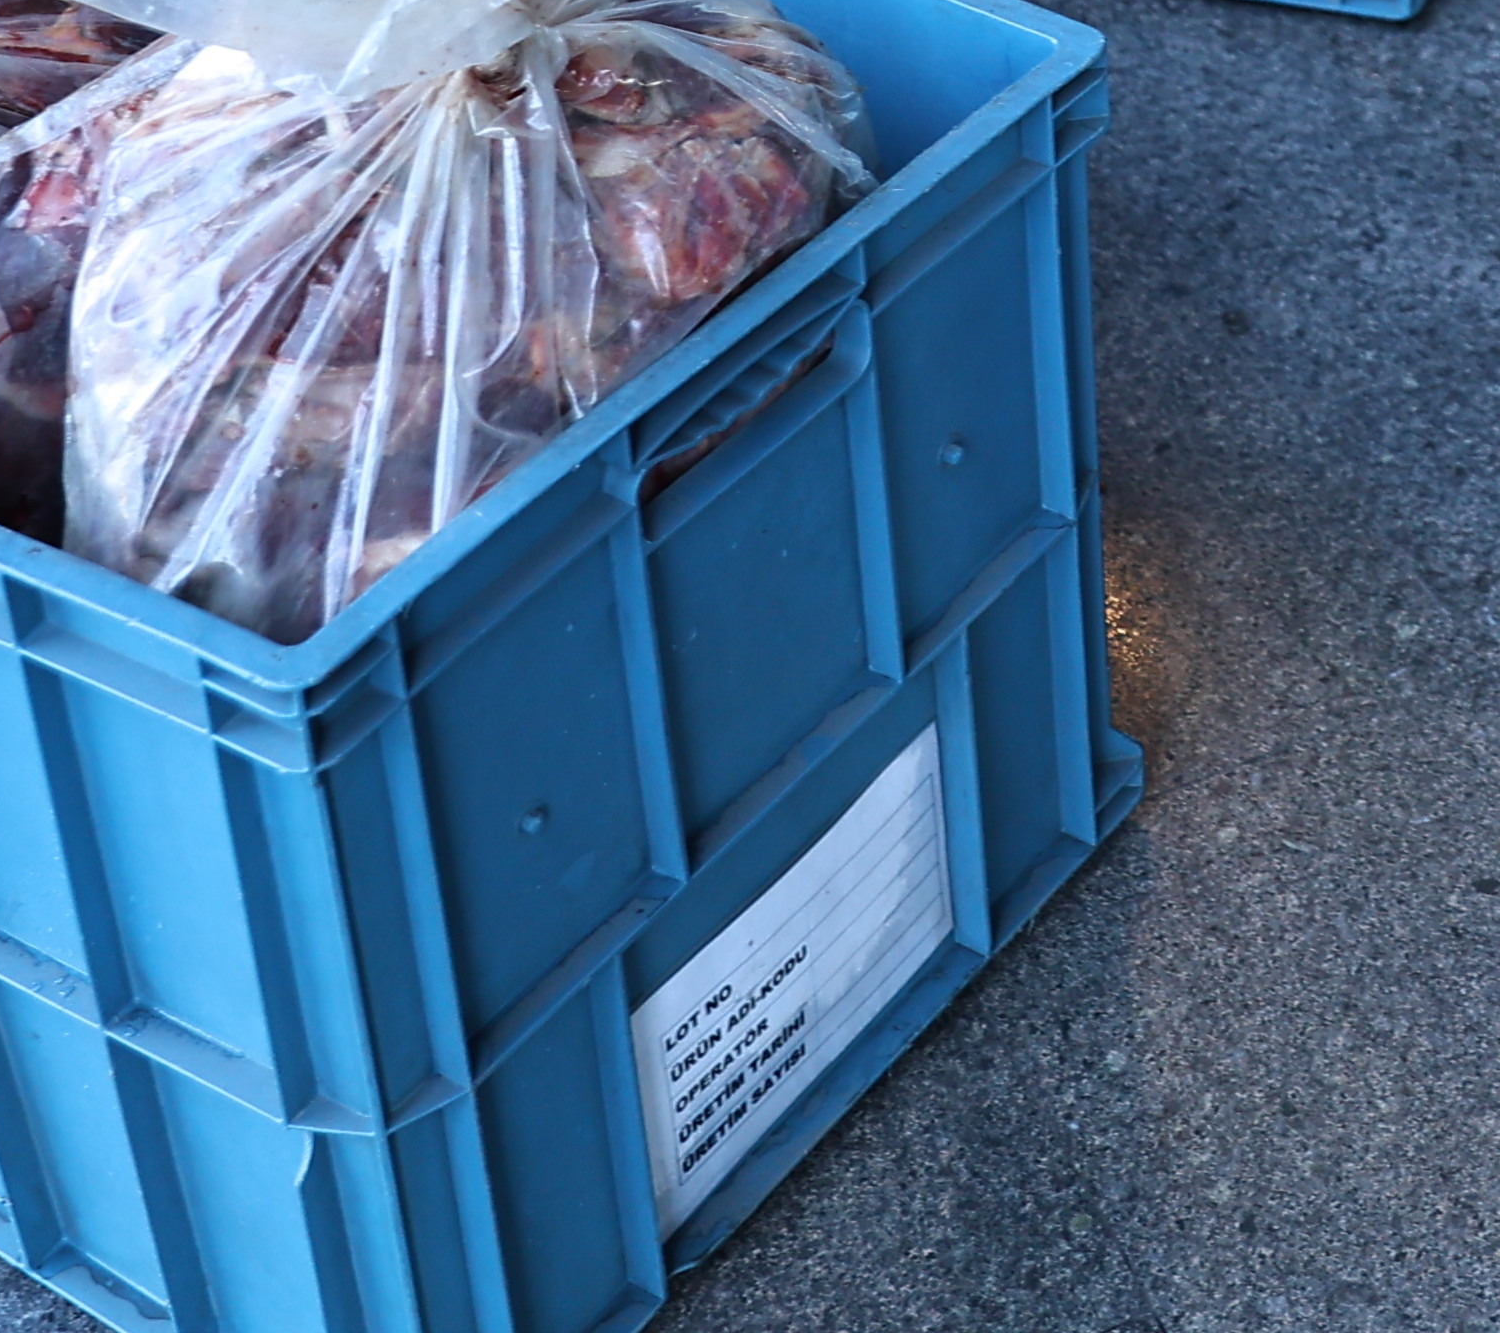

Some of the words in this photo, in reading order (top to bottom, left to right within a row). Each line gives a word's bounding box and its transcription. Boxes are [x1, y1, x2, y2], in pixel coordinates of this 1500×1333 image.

[665, 1011, 701, 1052] LOT
[705, 984, 733, 1016] NO
[670, 1028, 722, 1082] ÜRÜN
[678, 1072, 745, 1144] ÜRETİM
[682, 1101, 748, 1173] ÜRETİM
